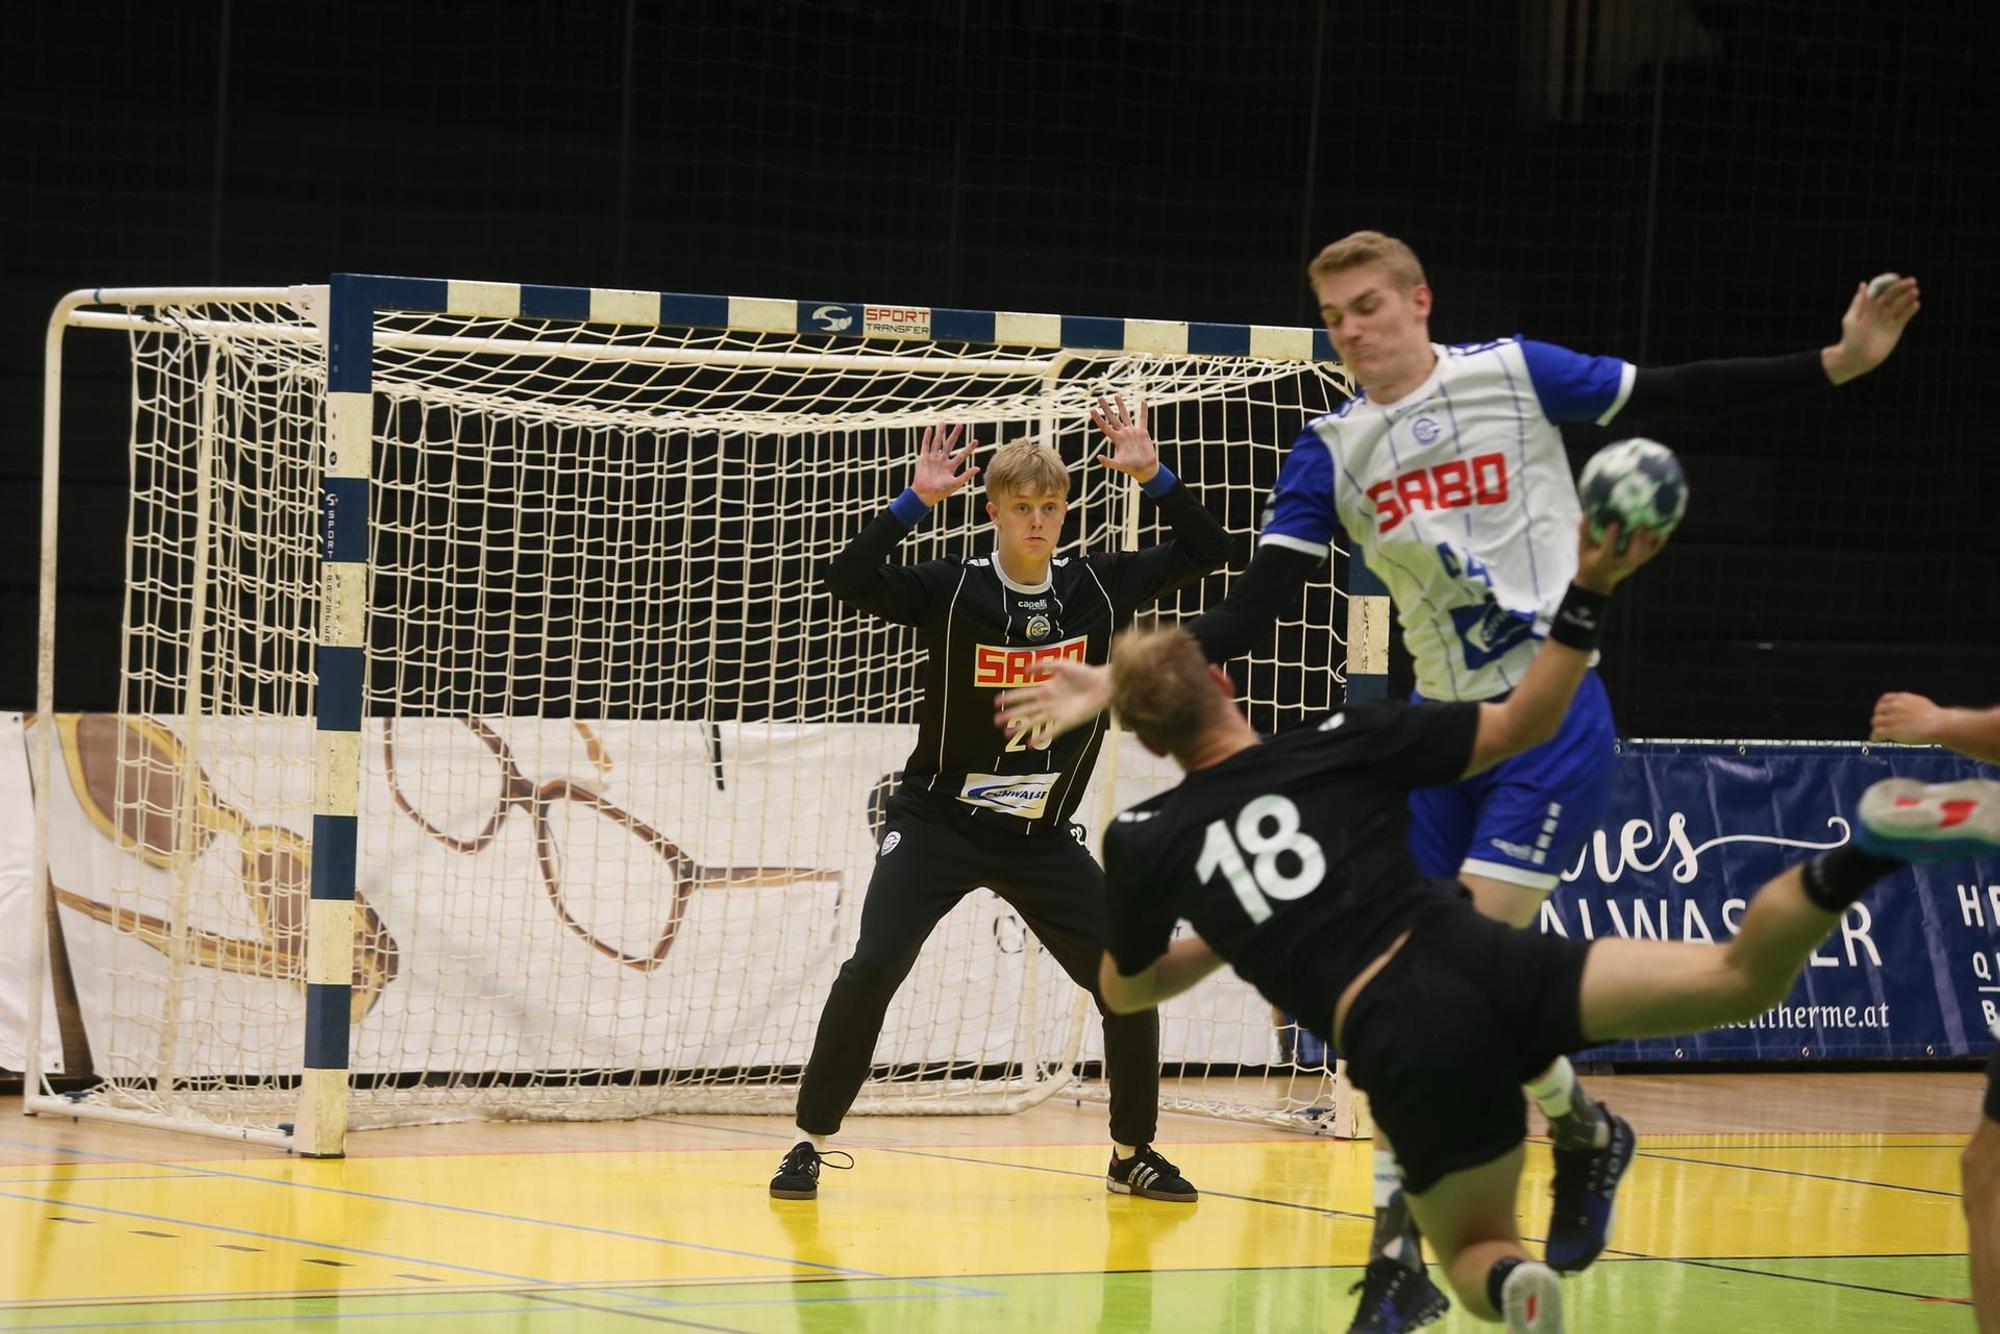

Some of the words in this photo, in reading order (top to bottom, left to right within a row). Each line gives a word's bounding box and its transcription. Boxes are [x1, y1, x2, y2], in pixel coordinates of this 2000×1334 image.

[866, 308, 929, 323] SPORT
[866, 323, 929, 335] TRANSFER
[1366, 452, 1510, 534] SABO
[327, 509, 336, 559] SPORT
[1018, 599, 1048, 610] capelli
[1195, 793, 1327, 925] 18
